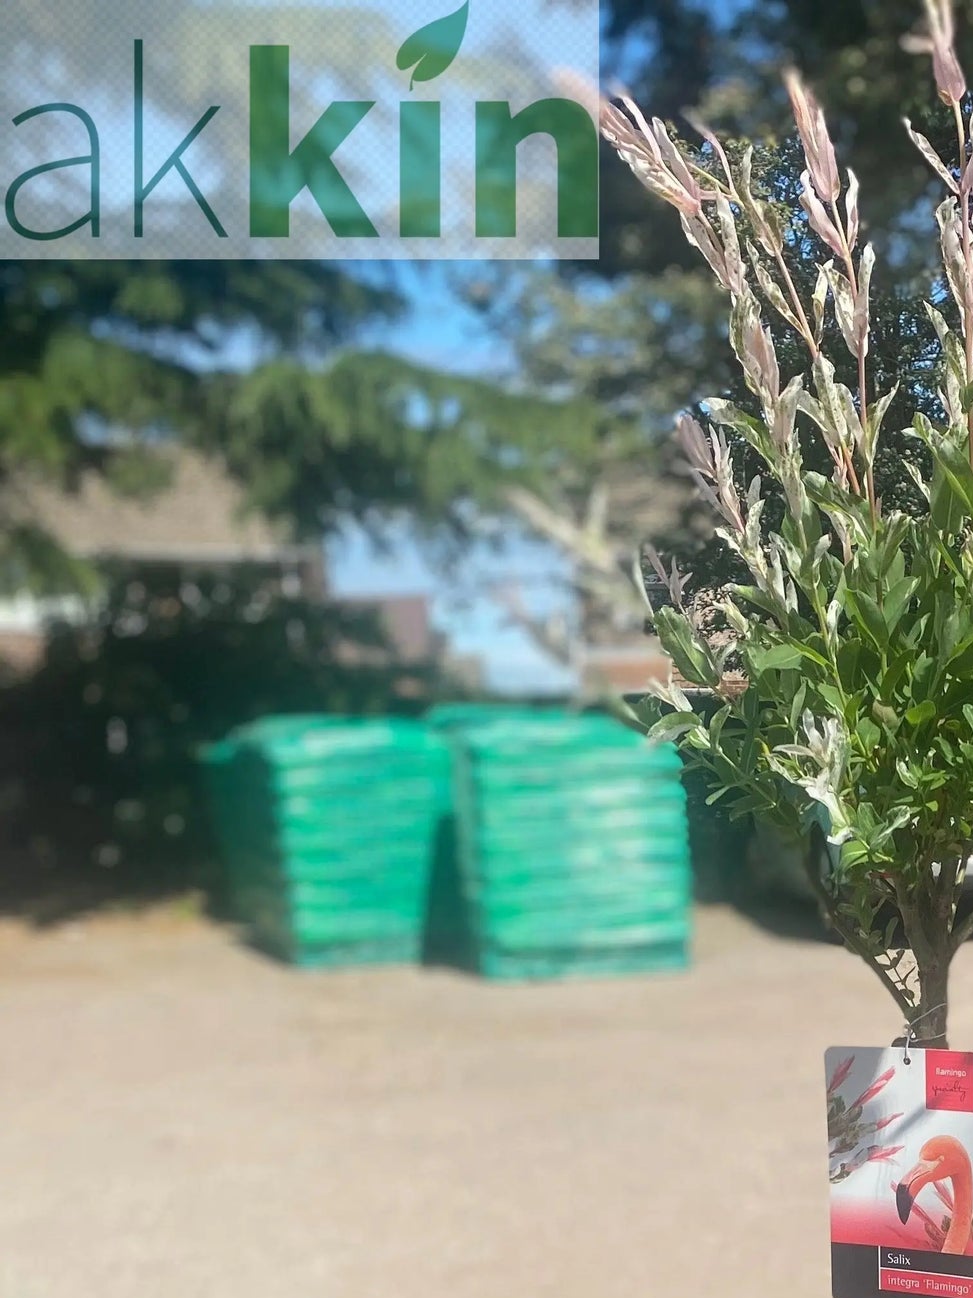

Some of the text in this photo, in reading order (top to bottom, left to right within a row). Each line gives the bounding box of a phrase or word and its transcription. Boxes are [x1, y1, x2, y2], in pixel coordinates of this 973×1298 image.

[935, 1067, 967, 1078] flamingo
[887, 1253, 911, 1266] Salix
[887, 1275, 920, 1289] integra
